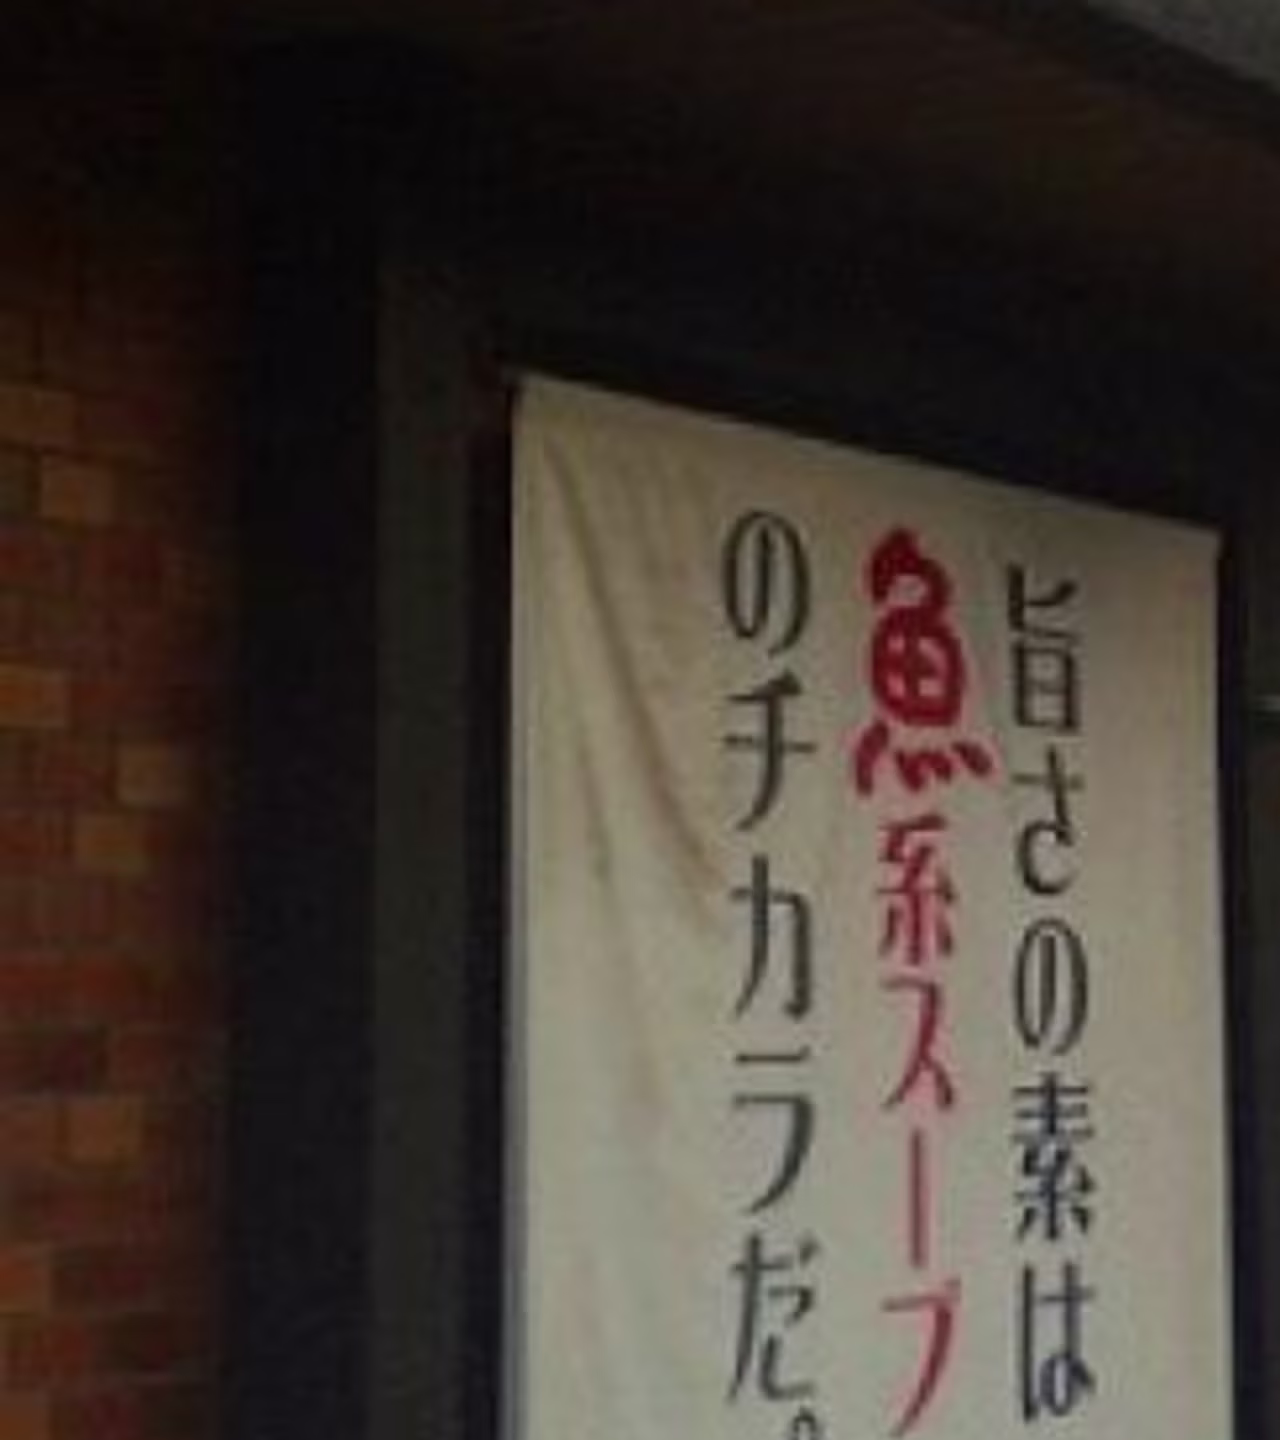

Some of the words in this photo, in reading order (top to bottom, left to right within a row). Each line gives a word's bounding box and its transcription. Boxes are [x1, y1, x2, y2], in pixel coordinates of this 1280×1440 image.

[853, 526, 995, 1438] 魚系スープ
[1005, 563, 1097, 1424] 旨さの素は
